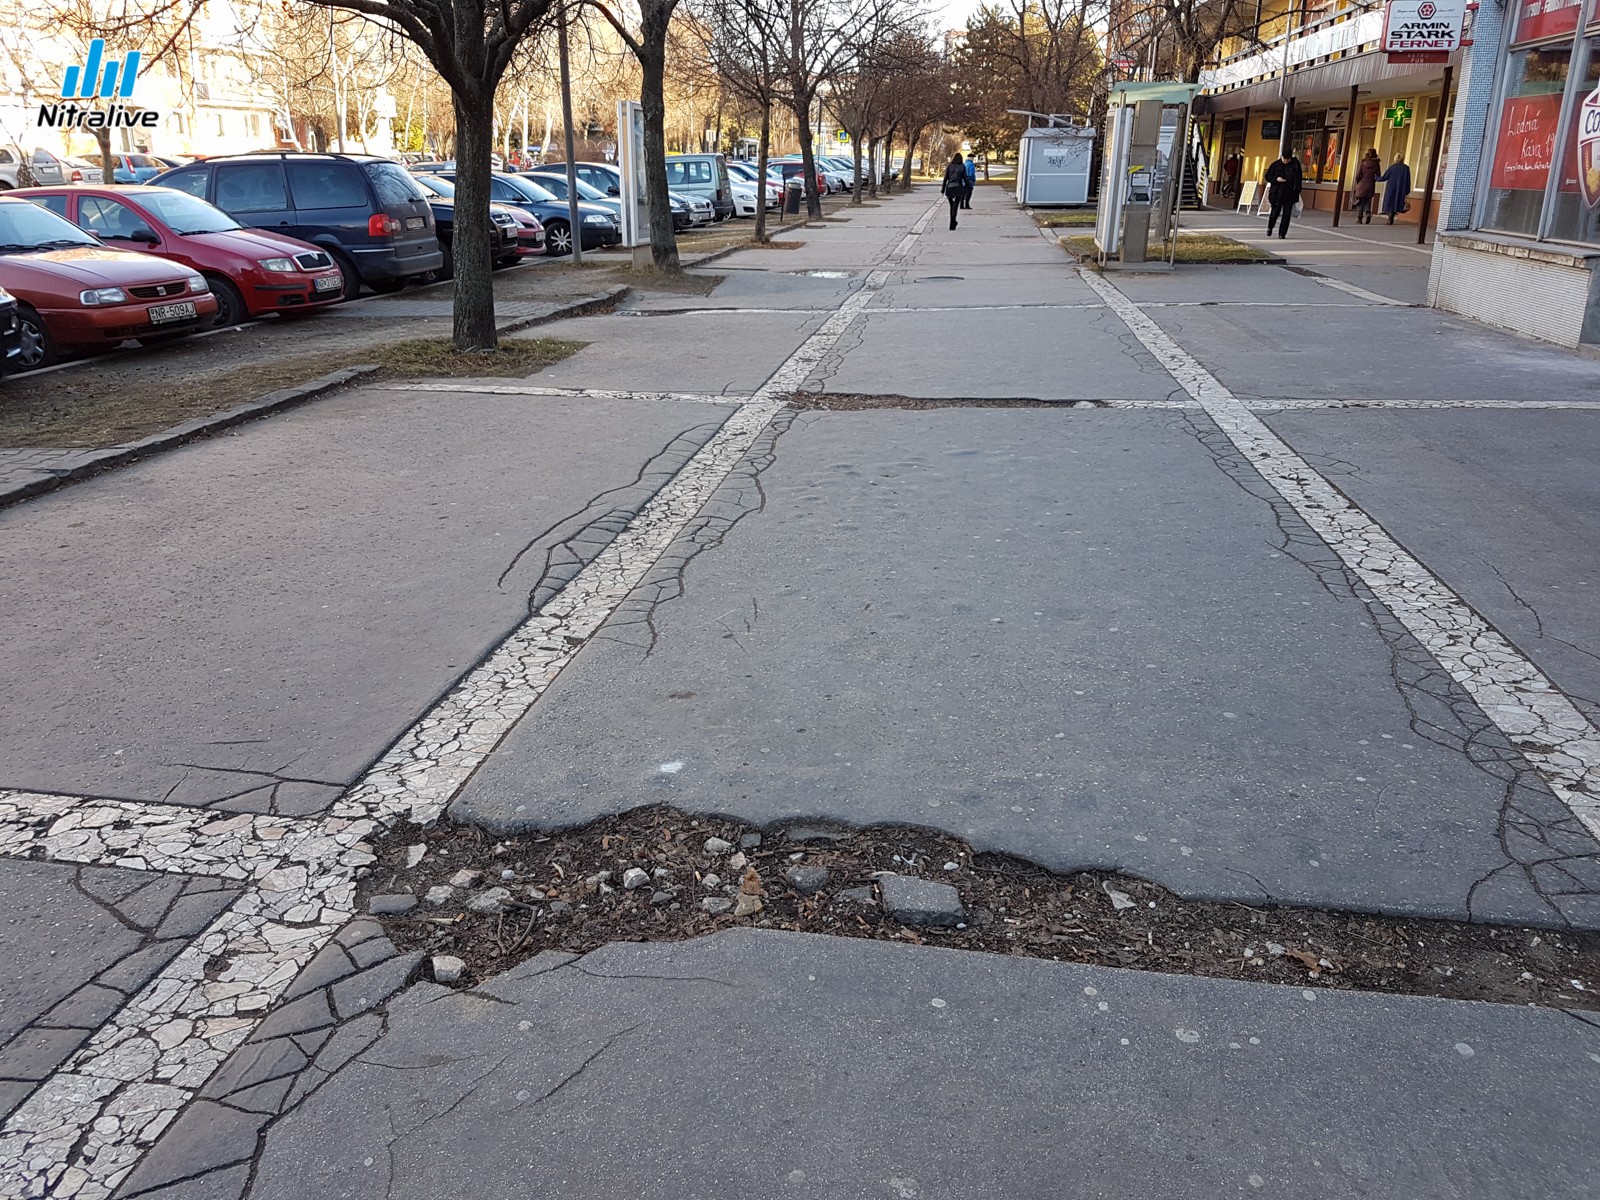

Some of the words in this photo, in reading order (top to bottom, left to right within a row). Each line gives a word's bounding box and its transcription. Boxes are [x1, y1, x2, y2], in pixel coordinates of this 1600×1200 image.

[1399, 22, 1450, 30] ARMIN
[1390, 30, 1456, 39] STARK
[1389, 40, 1456, 48] FERNET
